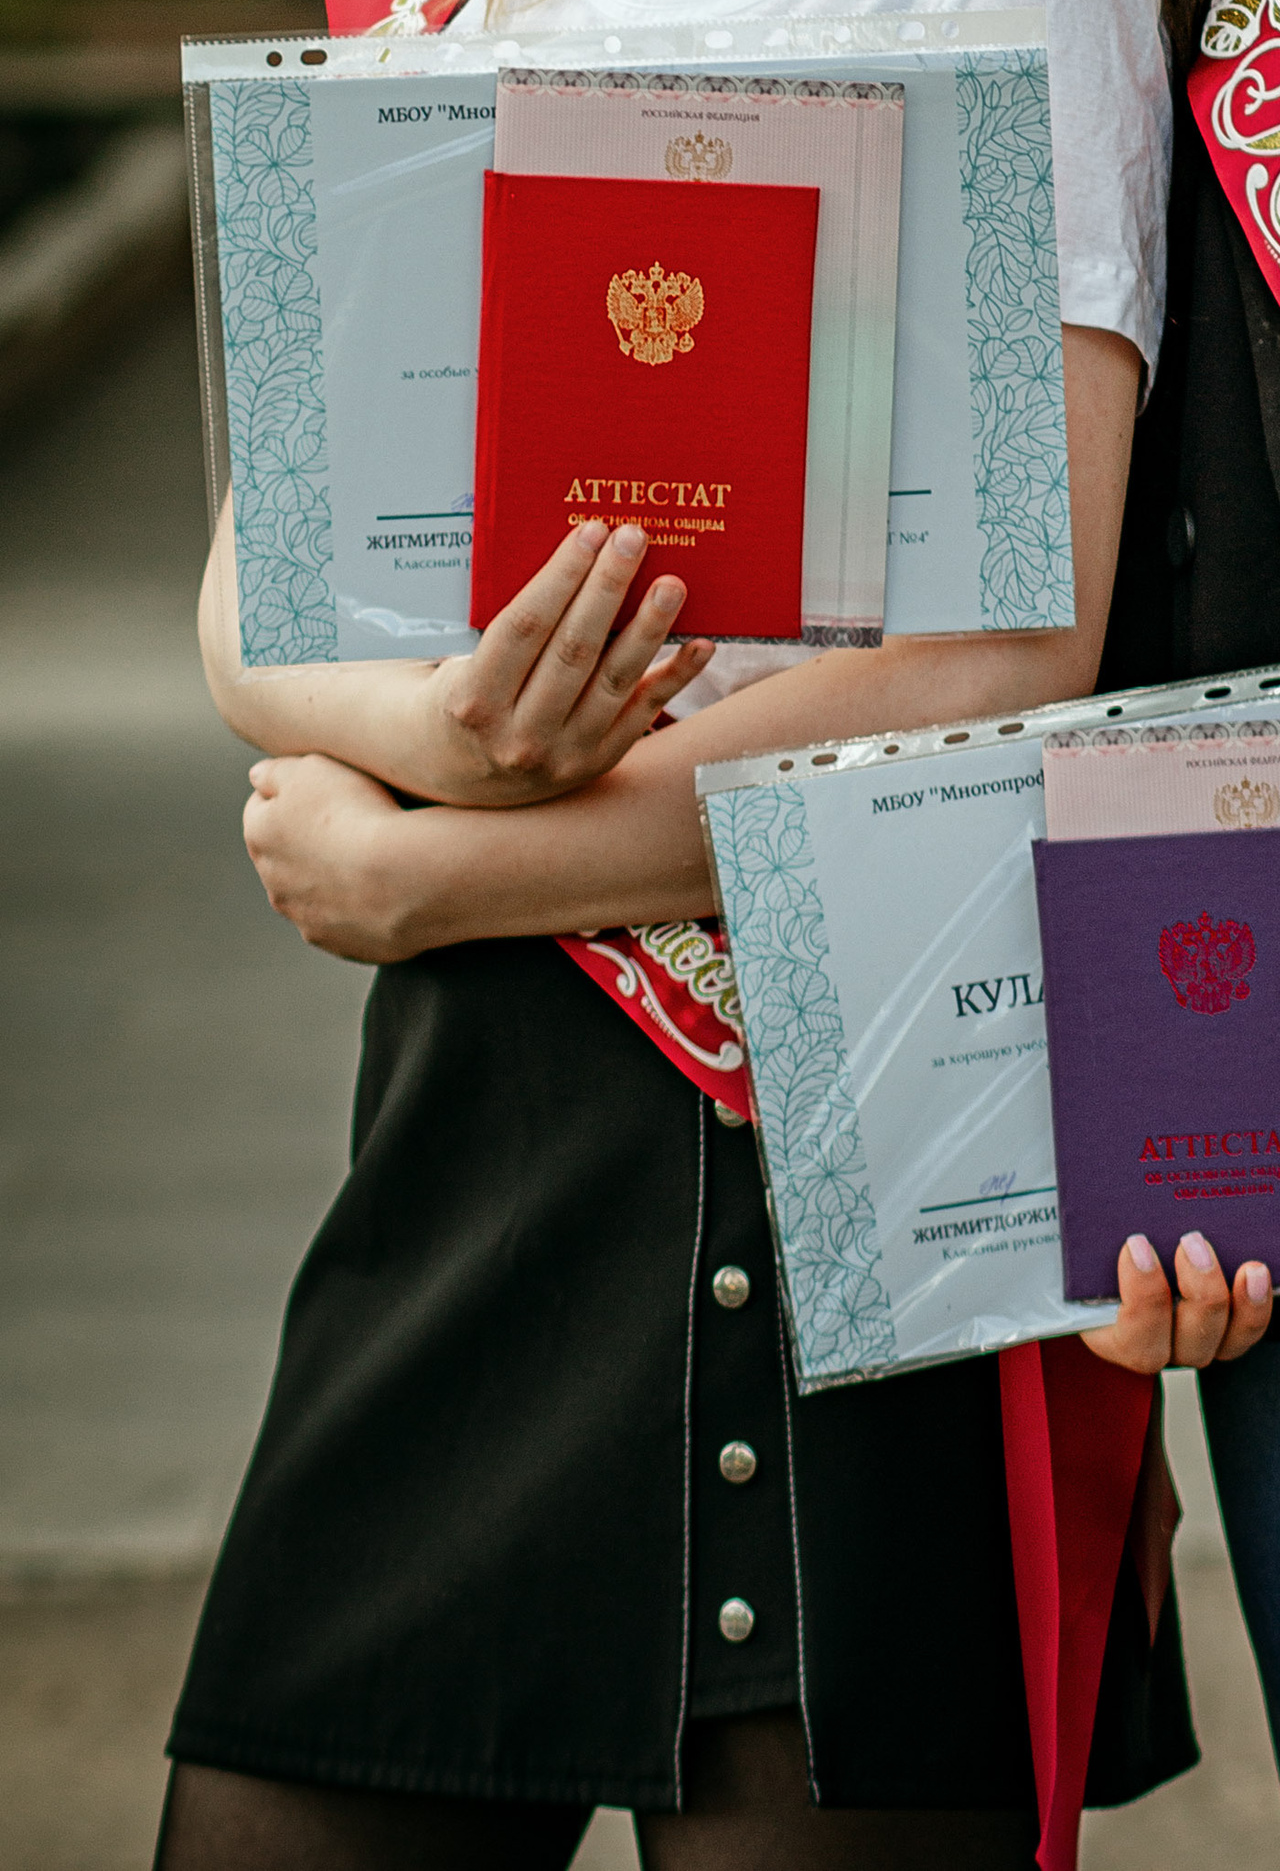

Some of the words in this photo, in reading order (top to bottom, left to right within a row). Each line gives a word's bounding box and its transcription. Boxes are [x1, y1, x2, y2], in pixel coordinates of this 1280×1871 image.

[377, 106, 433, 124] МБОУ
[641, 109, 703, 120] РОССИЙСКАЯ
[706, 112, 760, 123] ФЕДЕРАЦИЯ
[418, 365, 471, 379] особые
[563, 478, 732, 508] АТТЕСТАТ
[366, 531, 473, 550] ЖИГМИТДО
[393, 557, 461, 571] Классный
[1185, 756, 1248, 769] РОССИЙСКАЯ
[871, 790, 925, 815] МБОУ
[951, 973, 1045, 1017] КУЛ
[948, 1045, 1013, 1066] хорошую
[911, 1206, 1058, 1245] ЖИГМИТДОРЖИ
